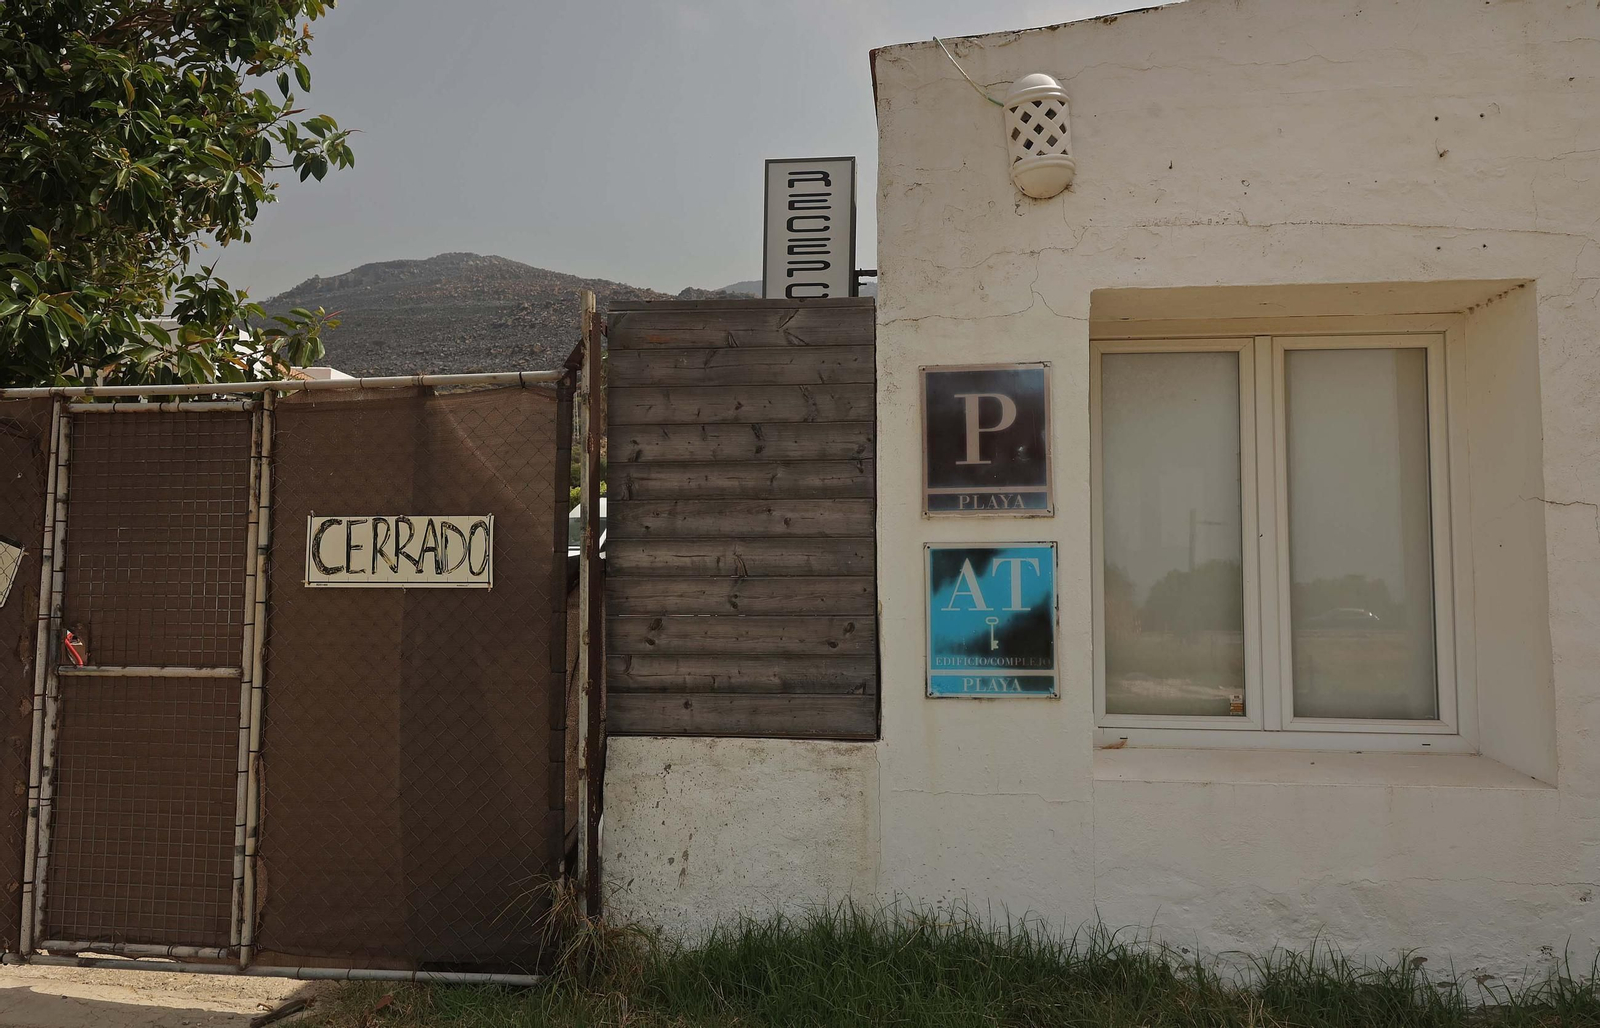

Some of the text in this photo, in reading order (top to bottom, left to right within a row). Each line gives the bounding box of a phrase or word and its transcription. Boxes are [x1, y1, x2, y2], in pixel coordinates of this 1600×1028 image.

[954, 393, 1017, 465] P
[957, 494, 1026, 510] PLAYA
[312, 515, 489, 576] CERRADO
[941, 557, 1040, 611] AT
[962, 677, 1023, 692] PLAYA
